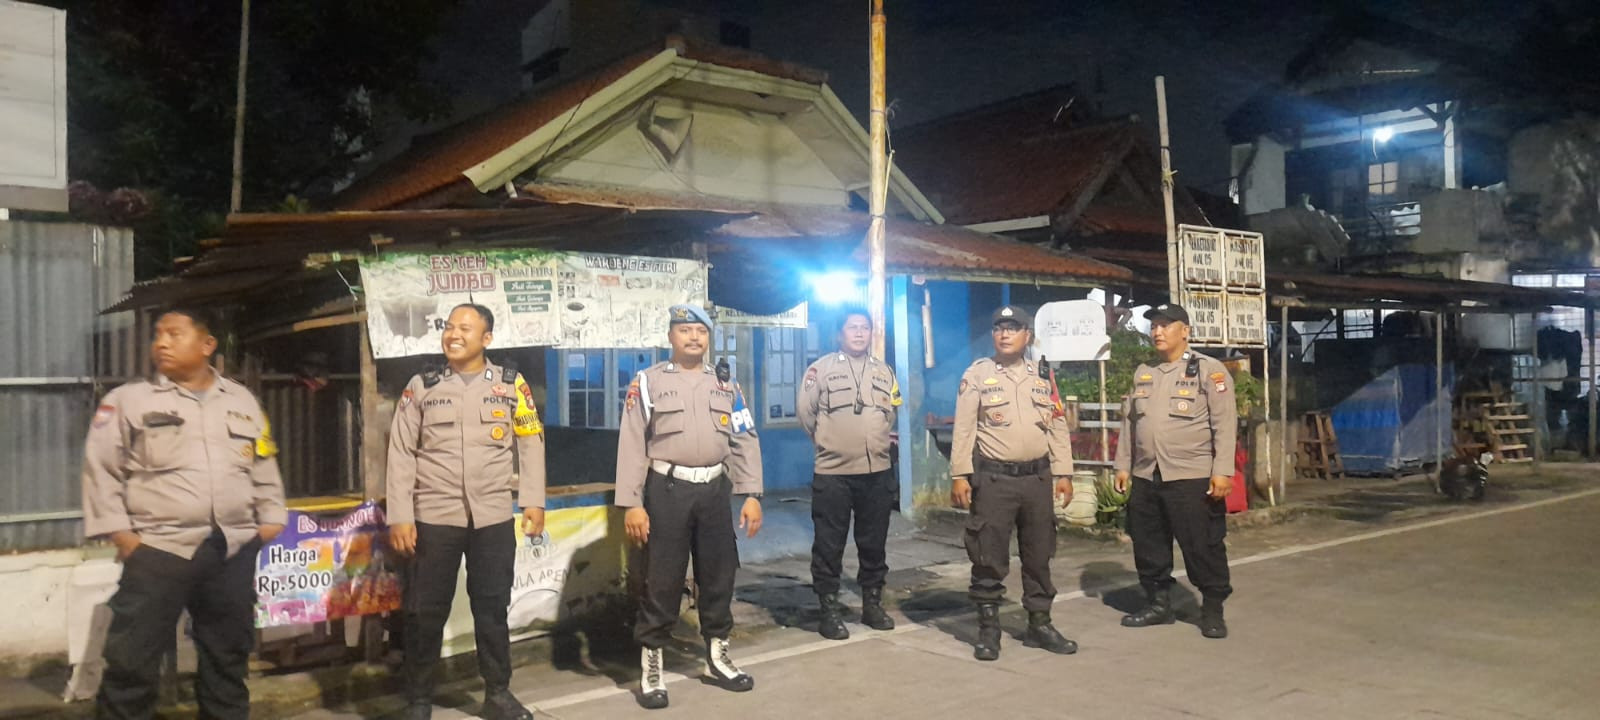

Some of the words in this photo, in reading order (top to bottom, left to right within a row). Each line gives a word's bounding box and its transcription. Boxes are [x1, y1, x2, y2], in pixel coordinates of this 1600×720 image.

[430, 255, 452, 272] ES
[455, 255, 487, 271] TEH
[427, 273, 496, 296] JUMBO
[423, 398, 453, 407] INDRA
[484, 397, 510, 405] POLRI
[270, 544, 317, 567] Harga
[257, 571, 332, 597] Rp.5000
